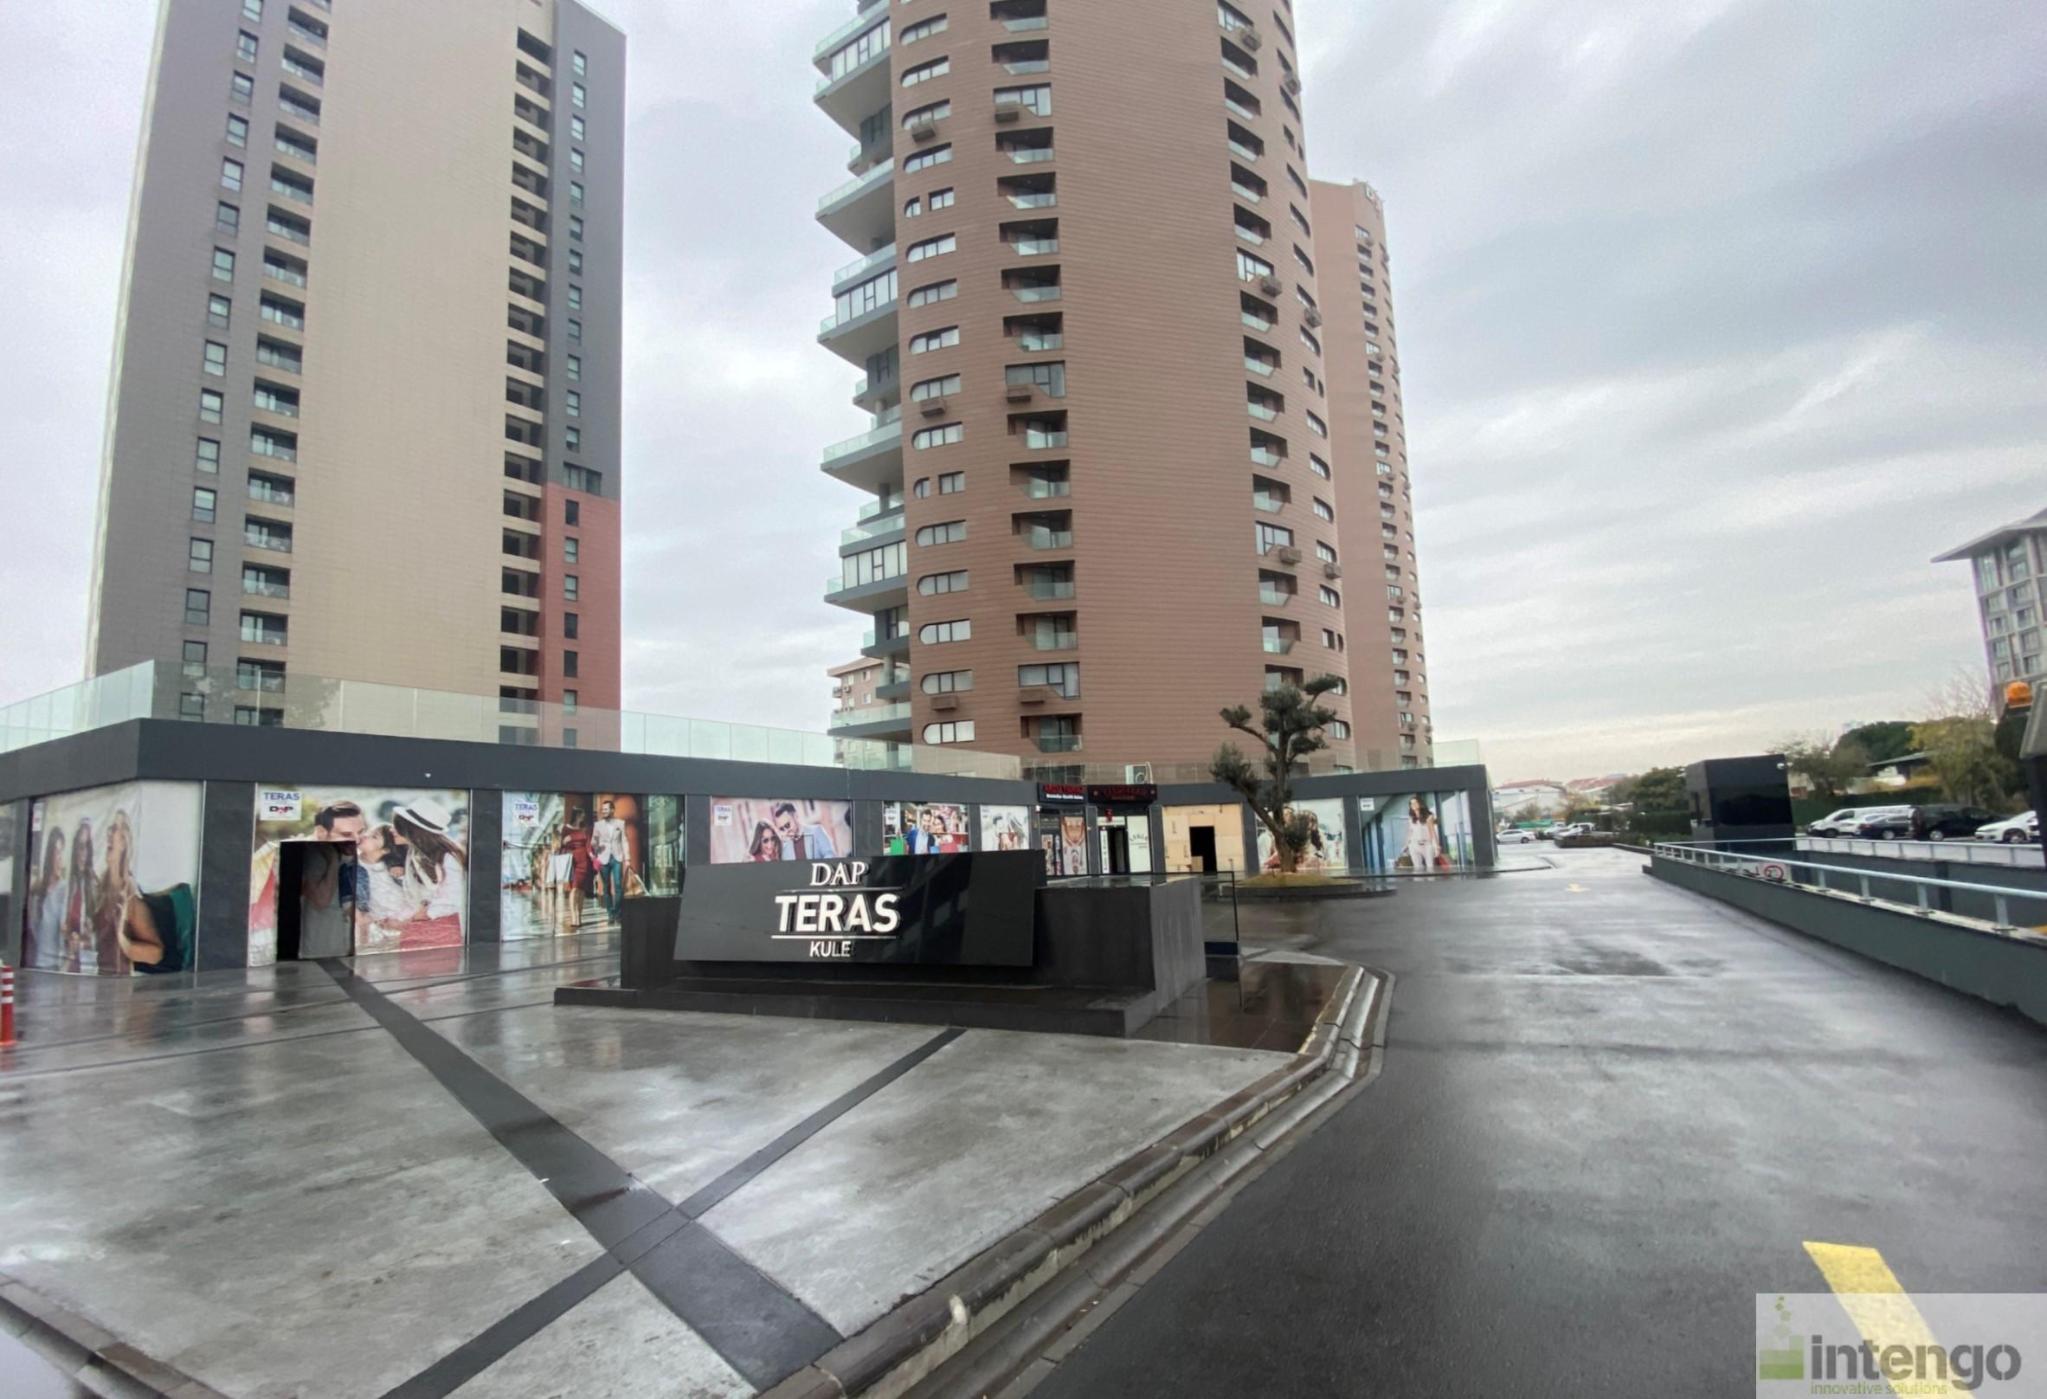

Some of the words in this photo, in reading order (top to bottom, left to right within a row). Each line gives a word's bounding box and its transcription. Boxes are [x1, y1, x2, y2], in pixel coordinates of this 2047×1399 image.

[264, 792, 300, 800] TERAS
[810, 862, 867, 886] DAP
[775, 893, 899, 932] TERAS
[809, 940, 851, 957] KULE
